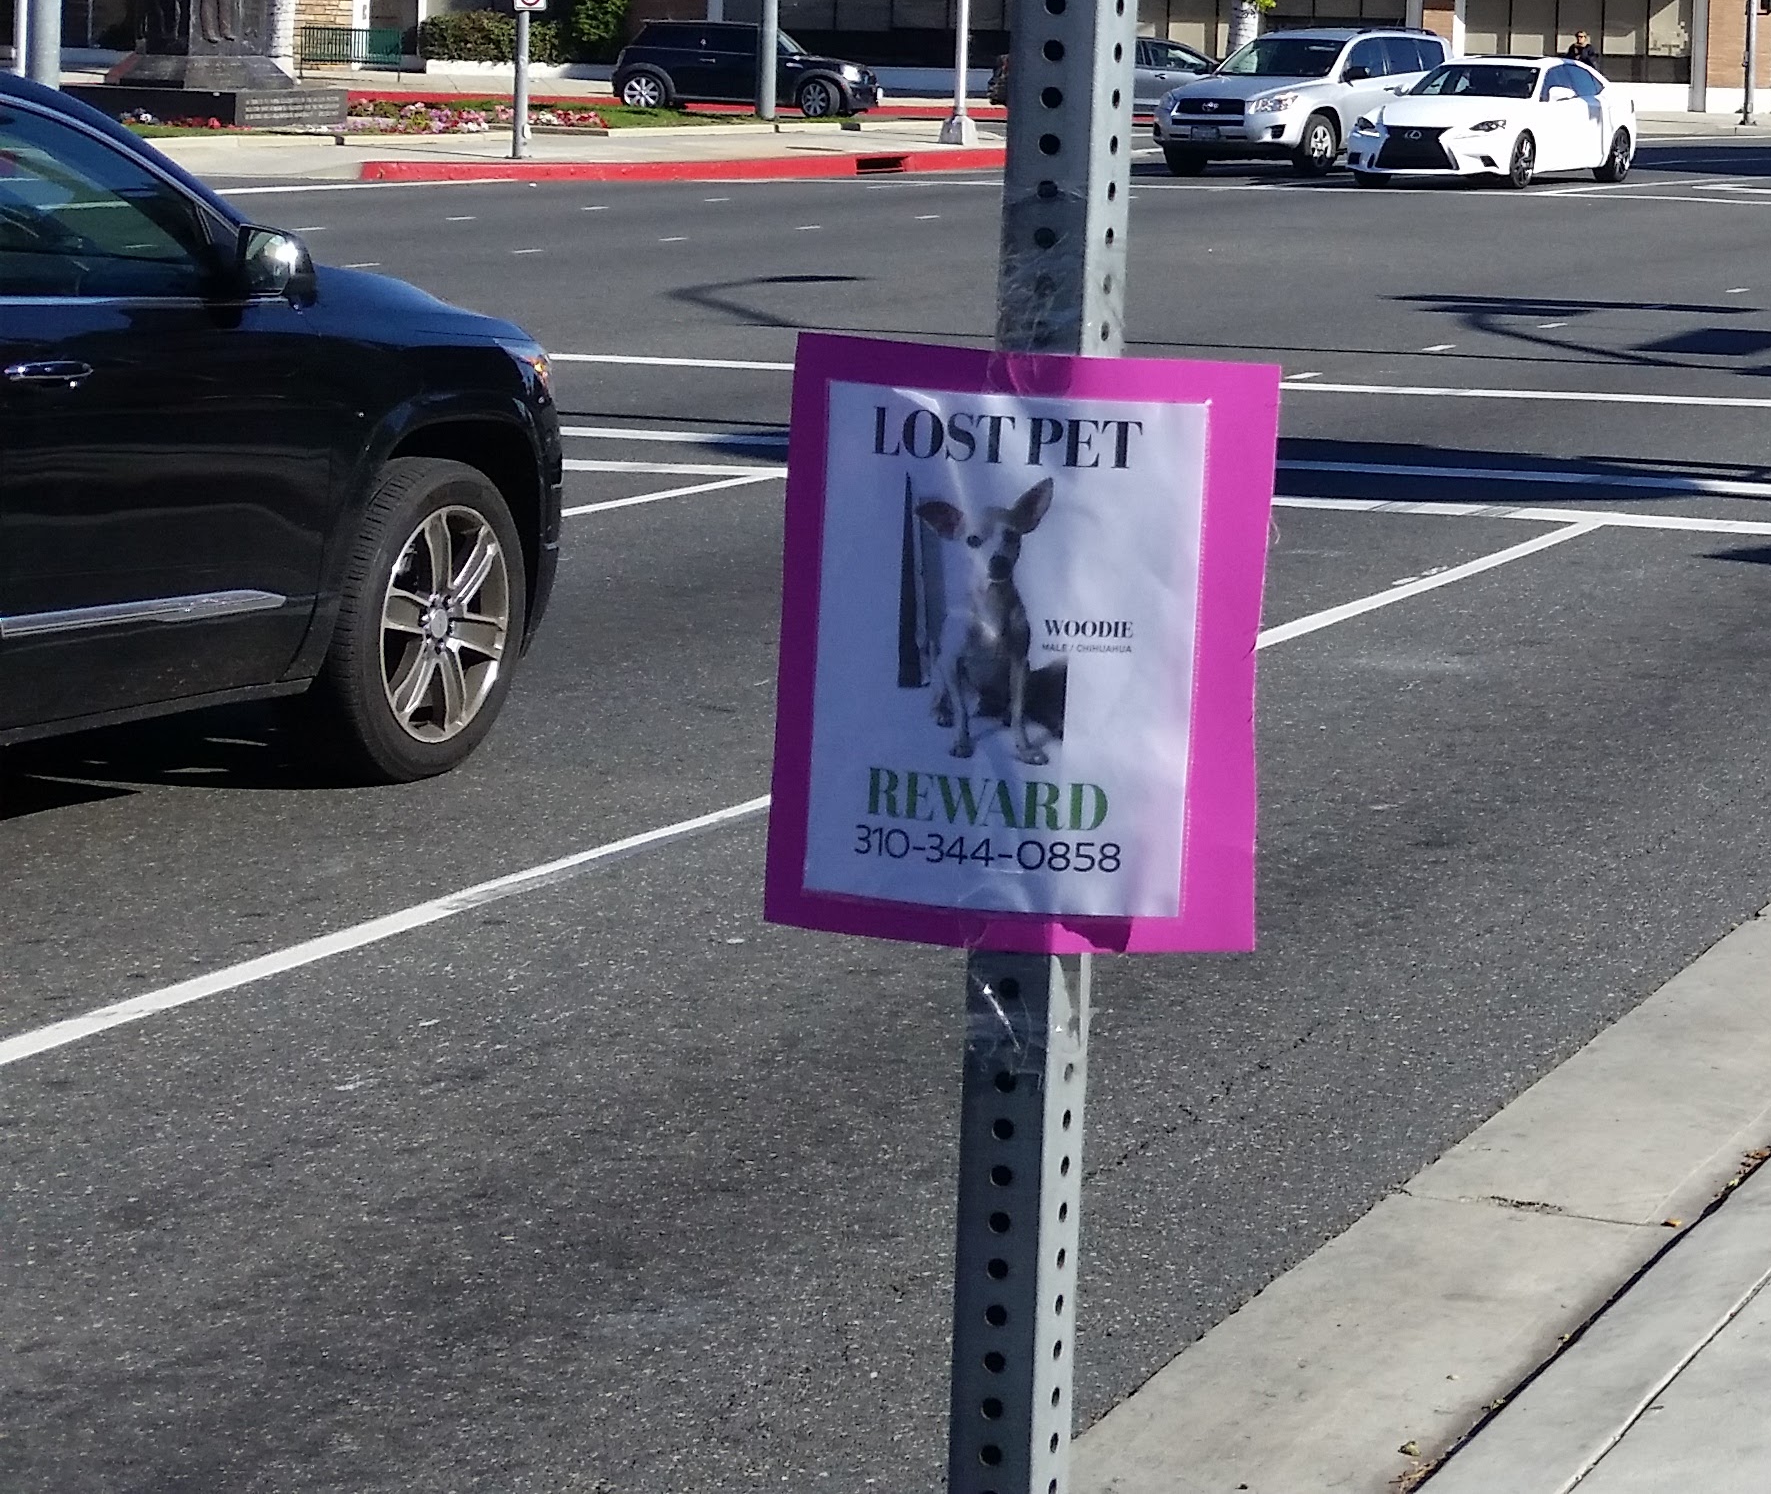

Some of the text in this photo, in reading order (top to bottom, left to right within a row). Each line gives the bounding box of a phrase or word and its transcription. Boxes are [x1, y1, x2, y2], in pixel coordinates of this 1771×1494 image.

[873, 406, 1143, 469] LOST PET
[1043, 619, 1134, 638] WOODIE
[867, 766, 1109, 832] REWARD
[854, 824, 1121, 873] 310-344-0858
